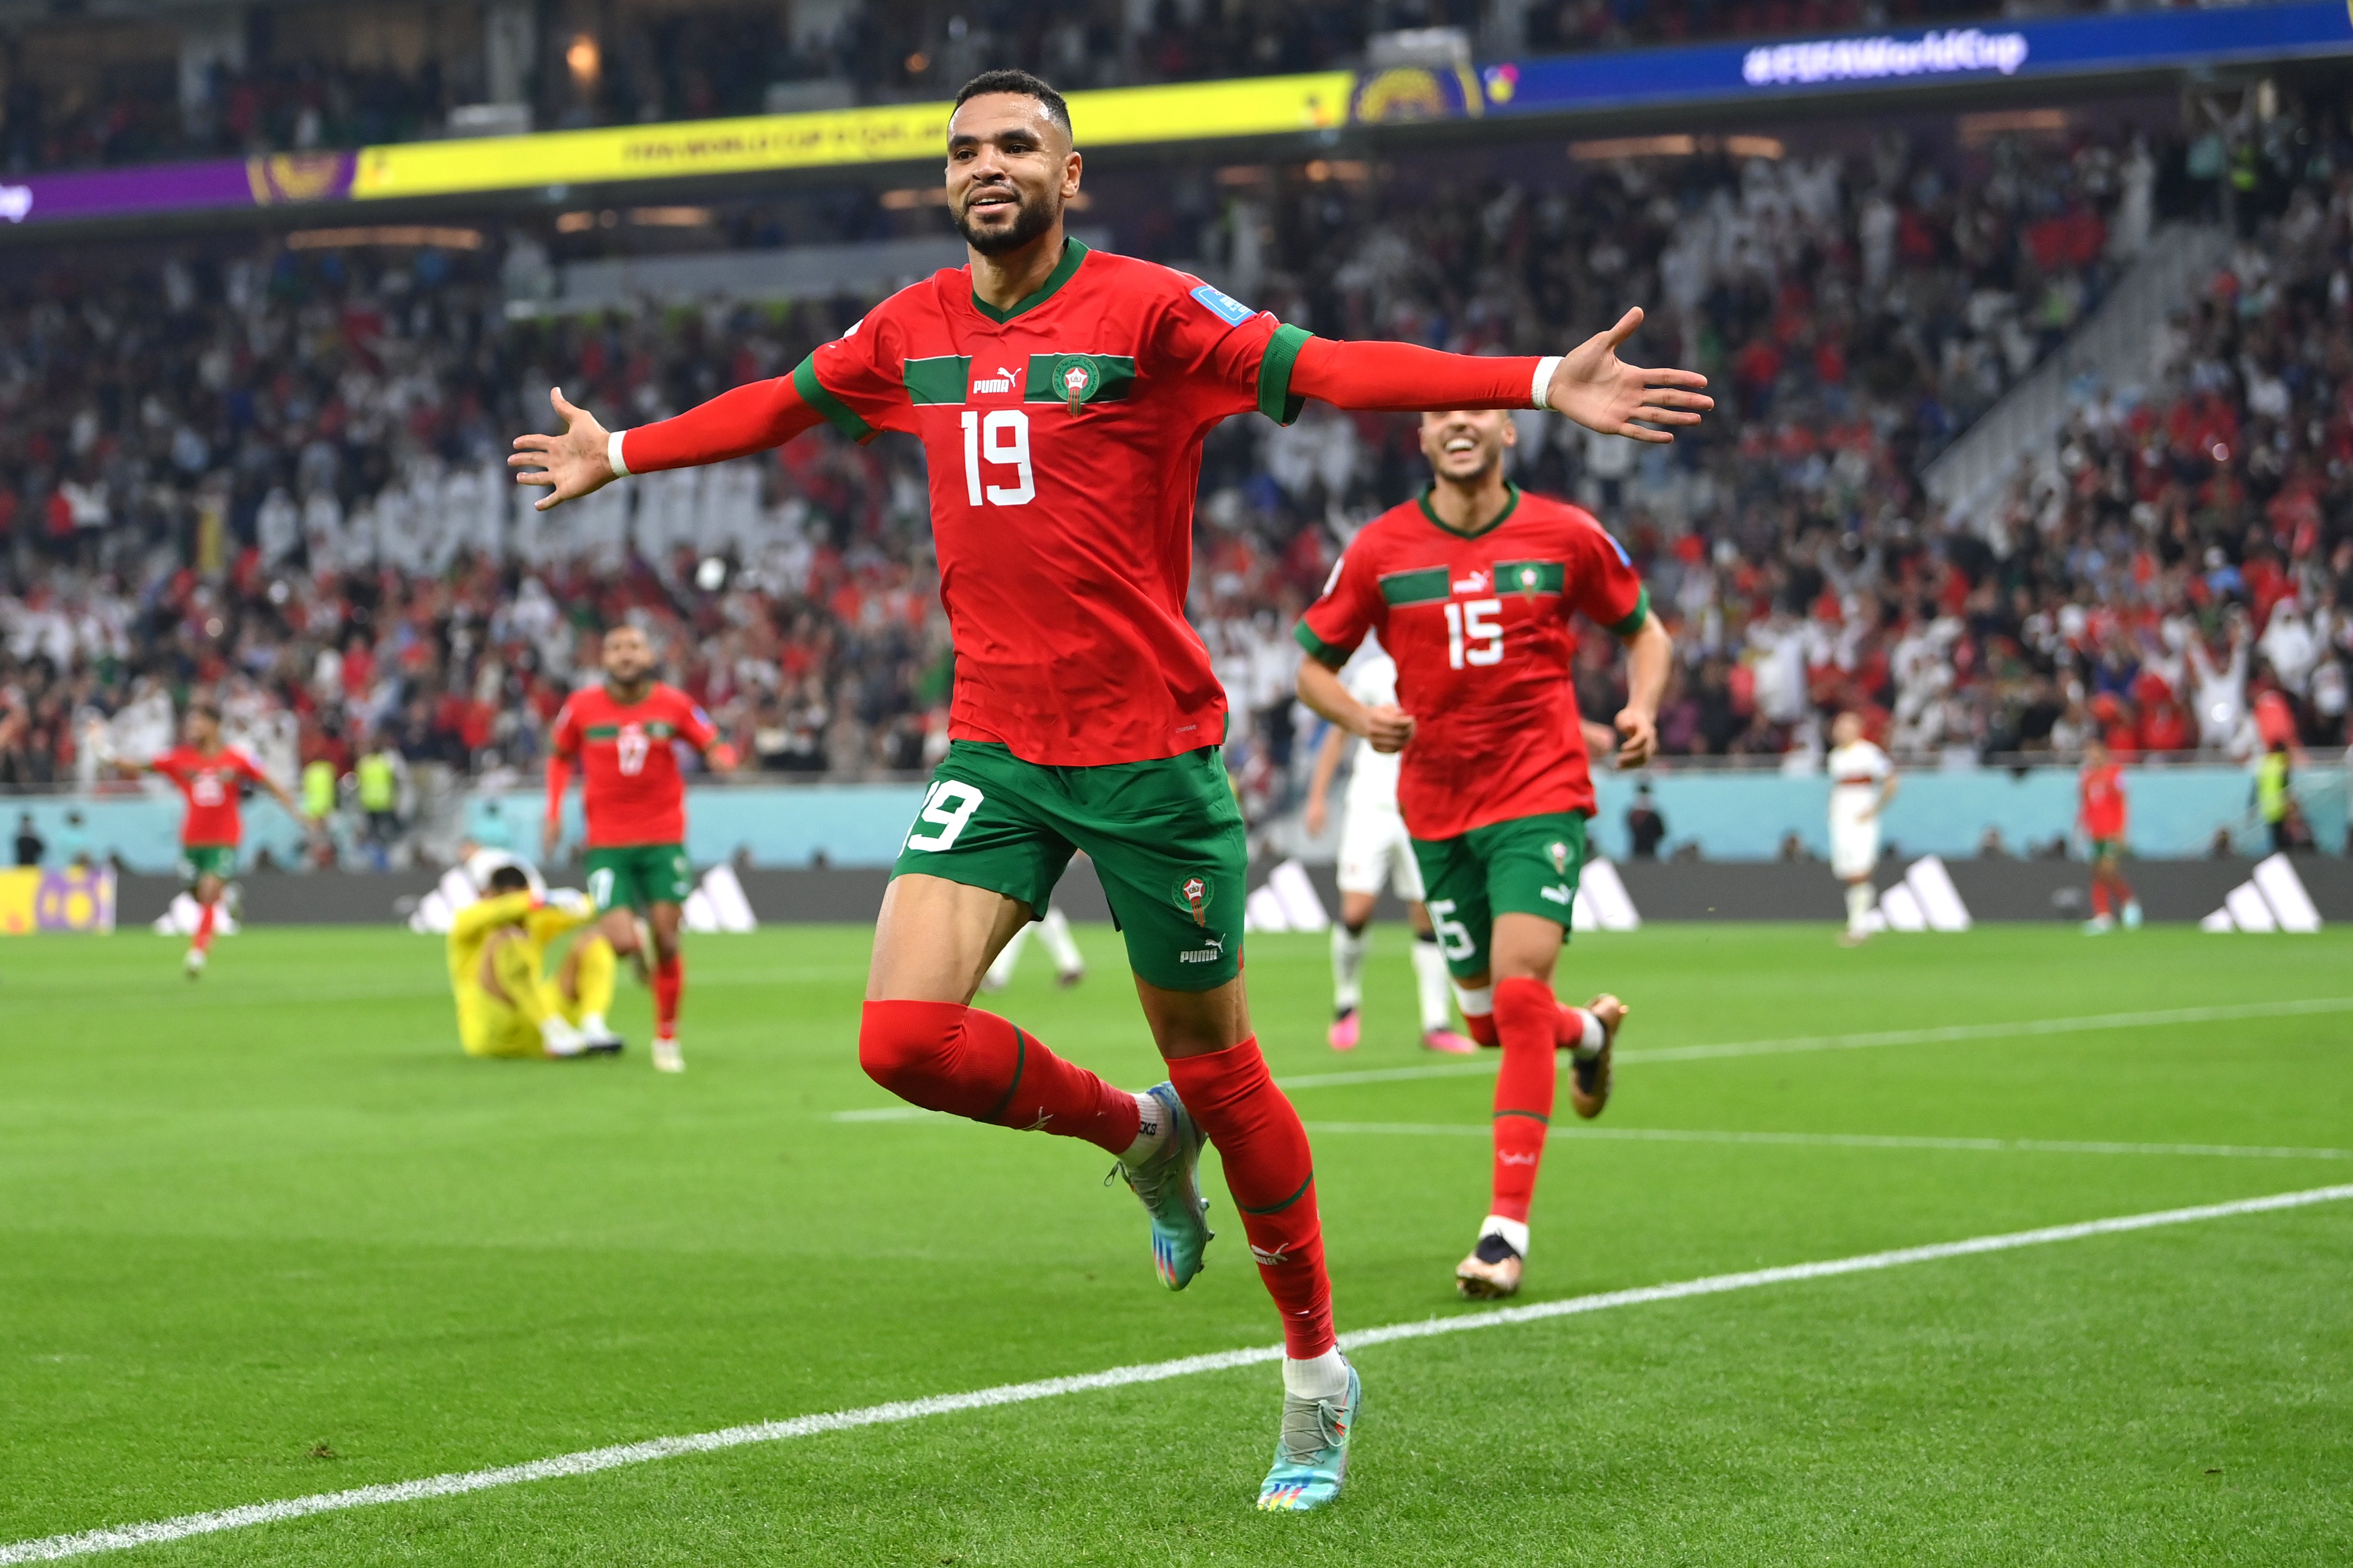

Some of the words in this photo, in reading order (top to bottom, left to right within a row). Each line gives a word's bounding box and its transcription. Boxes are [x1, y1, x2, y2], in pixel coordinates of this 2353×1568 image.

[973, 379, 1009, 394] PUMA
[961, 409, 1036, 506] 19
[1444, 598, 1504, 670] 15
[1179, 948, 1218, 963] PUMA
[1427, 899, 1476, 962] 5
